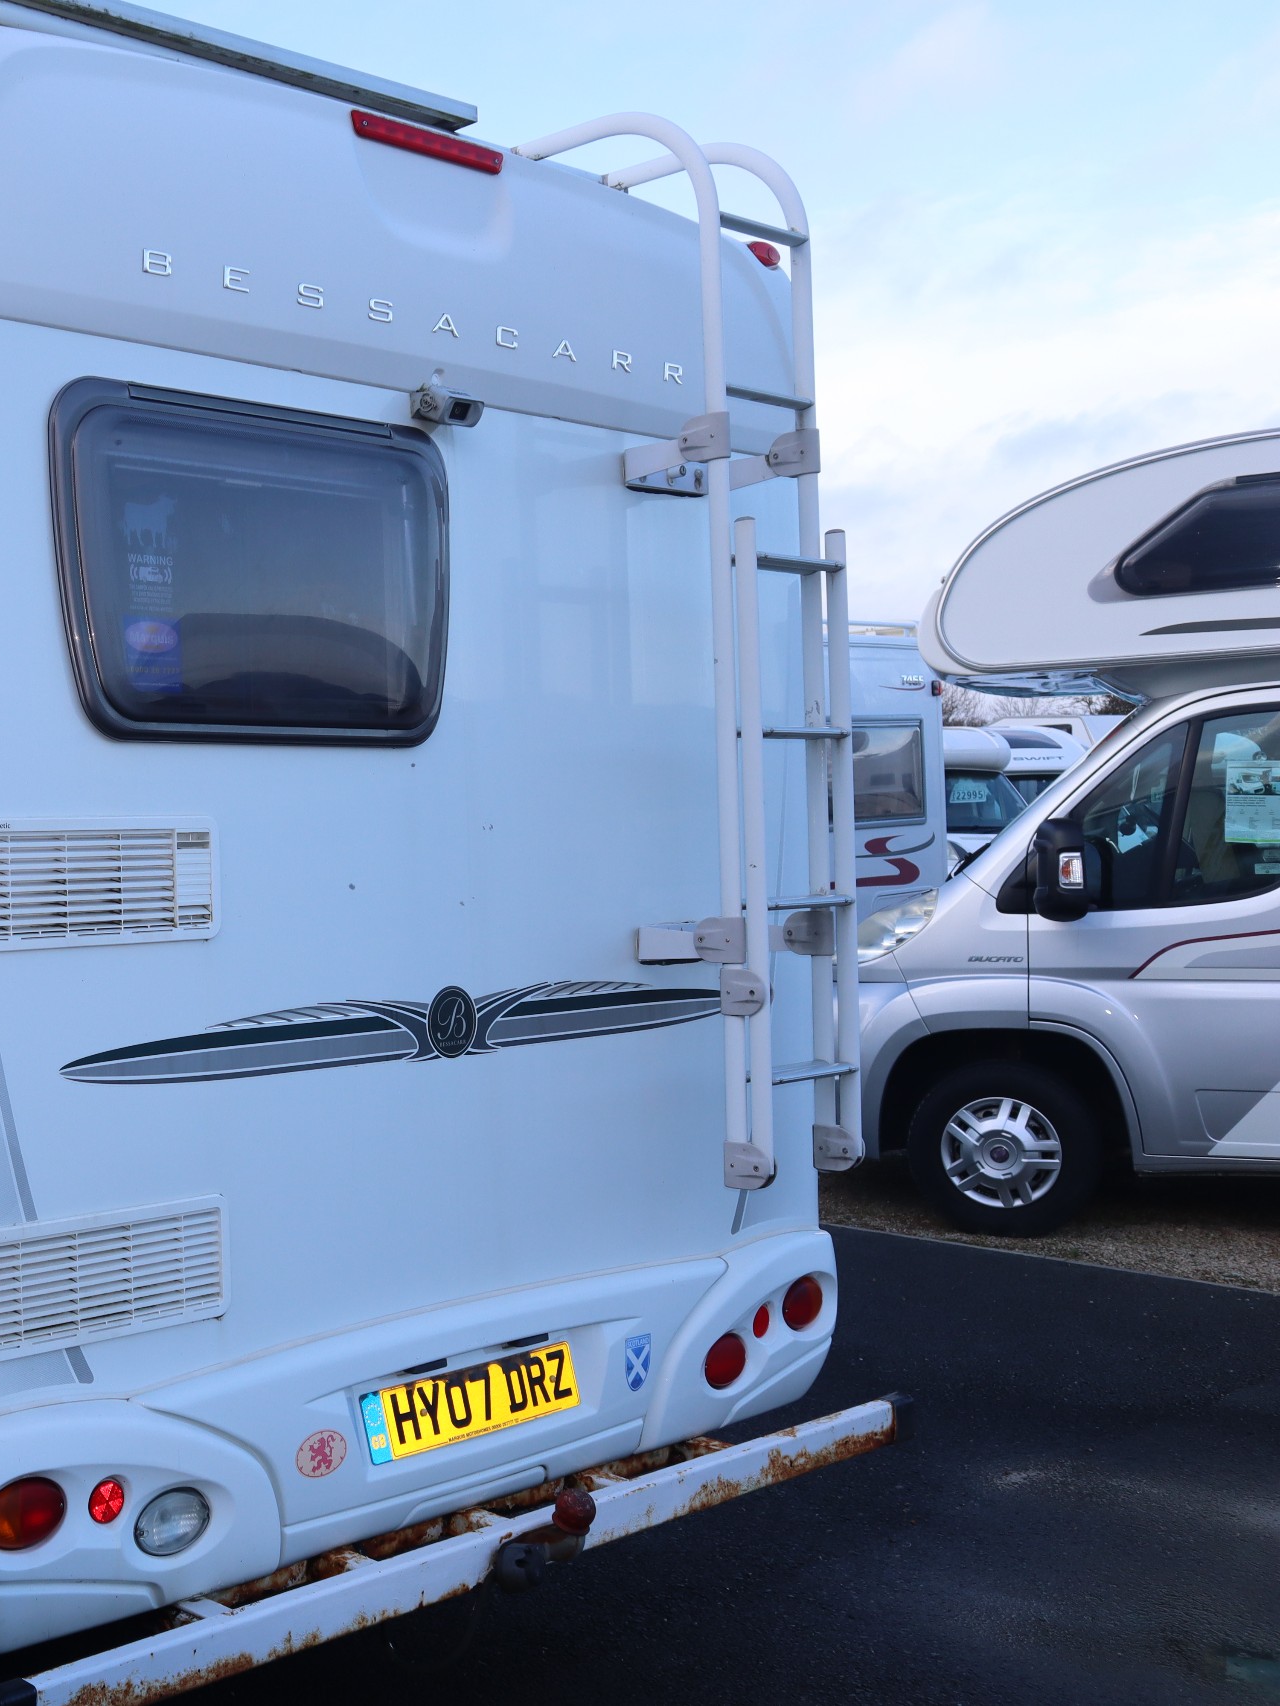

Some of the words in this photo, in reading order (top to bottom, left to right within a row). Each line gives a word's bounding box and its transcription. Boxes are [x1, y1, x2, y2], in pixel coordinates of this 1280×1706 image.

[142, 247, 683, 385] BESSACARR
[128, 553, 173, 566] WARNING
[967, 955, 1024, 963] DUCATO
[389, 1369, 492, 1445] HY07
[504, 1348, 573, 1414] DRZ
